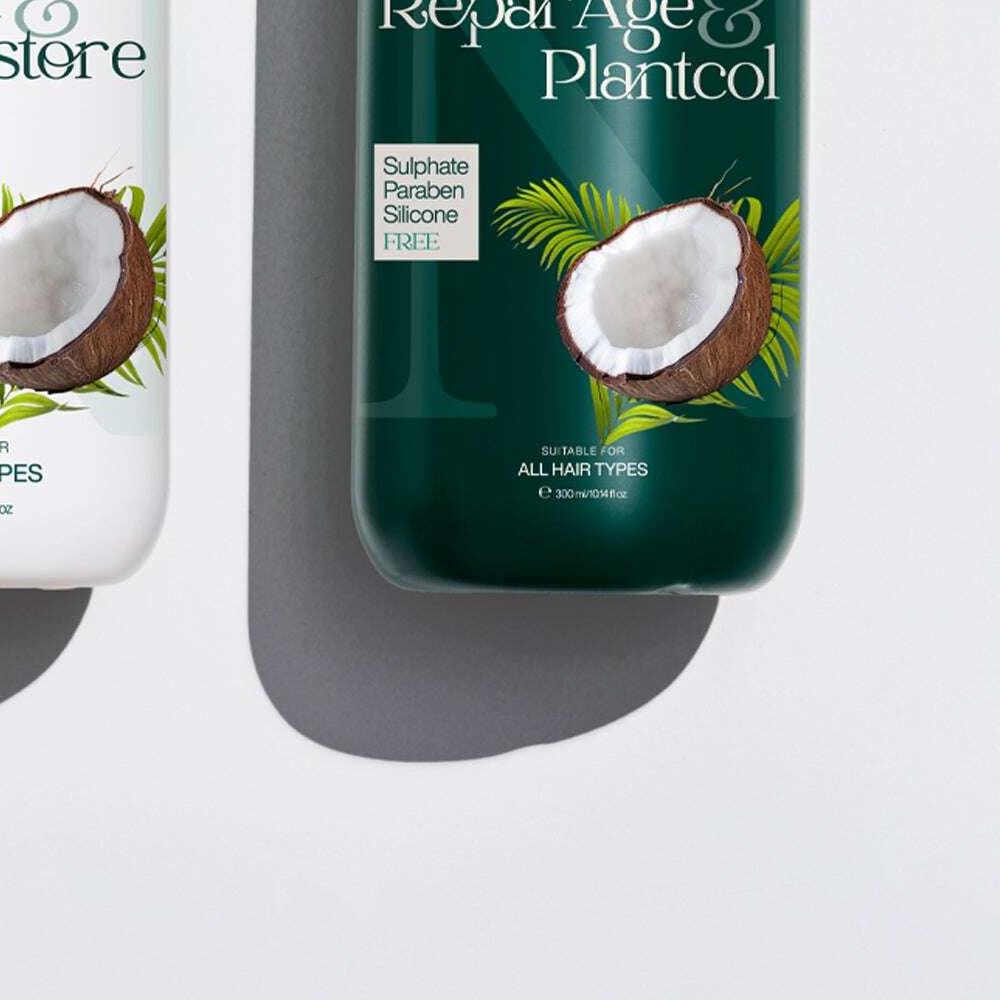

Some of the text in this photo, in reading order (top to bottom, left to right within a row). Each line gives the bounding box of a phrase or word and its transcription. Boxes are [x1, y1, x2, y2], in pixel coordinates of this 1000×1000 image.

[540, 44, 781, 101] Plantcol
[383, 156, 469, 179] Sulphate
[384, 180, 464, 199] Paraben
[383, 204, 458, 224] Silicone
[383, 232, 440, 250] FREE
[518, 463, 648, 476] ALL HAIR TYPES
[555, 489, 574, 499] 300
[616, 491, 627, 499] oz
